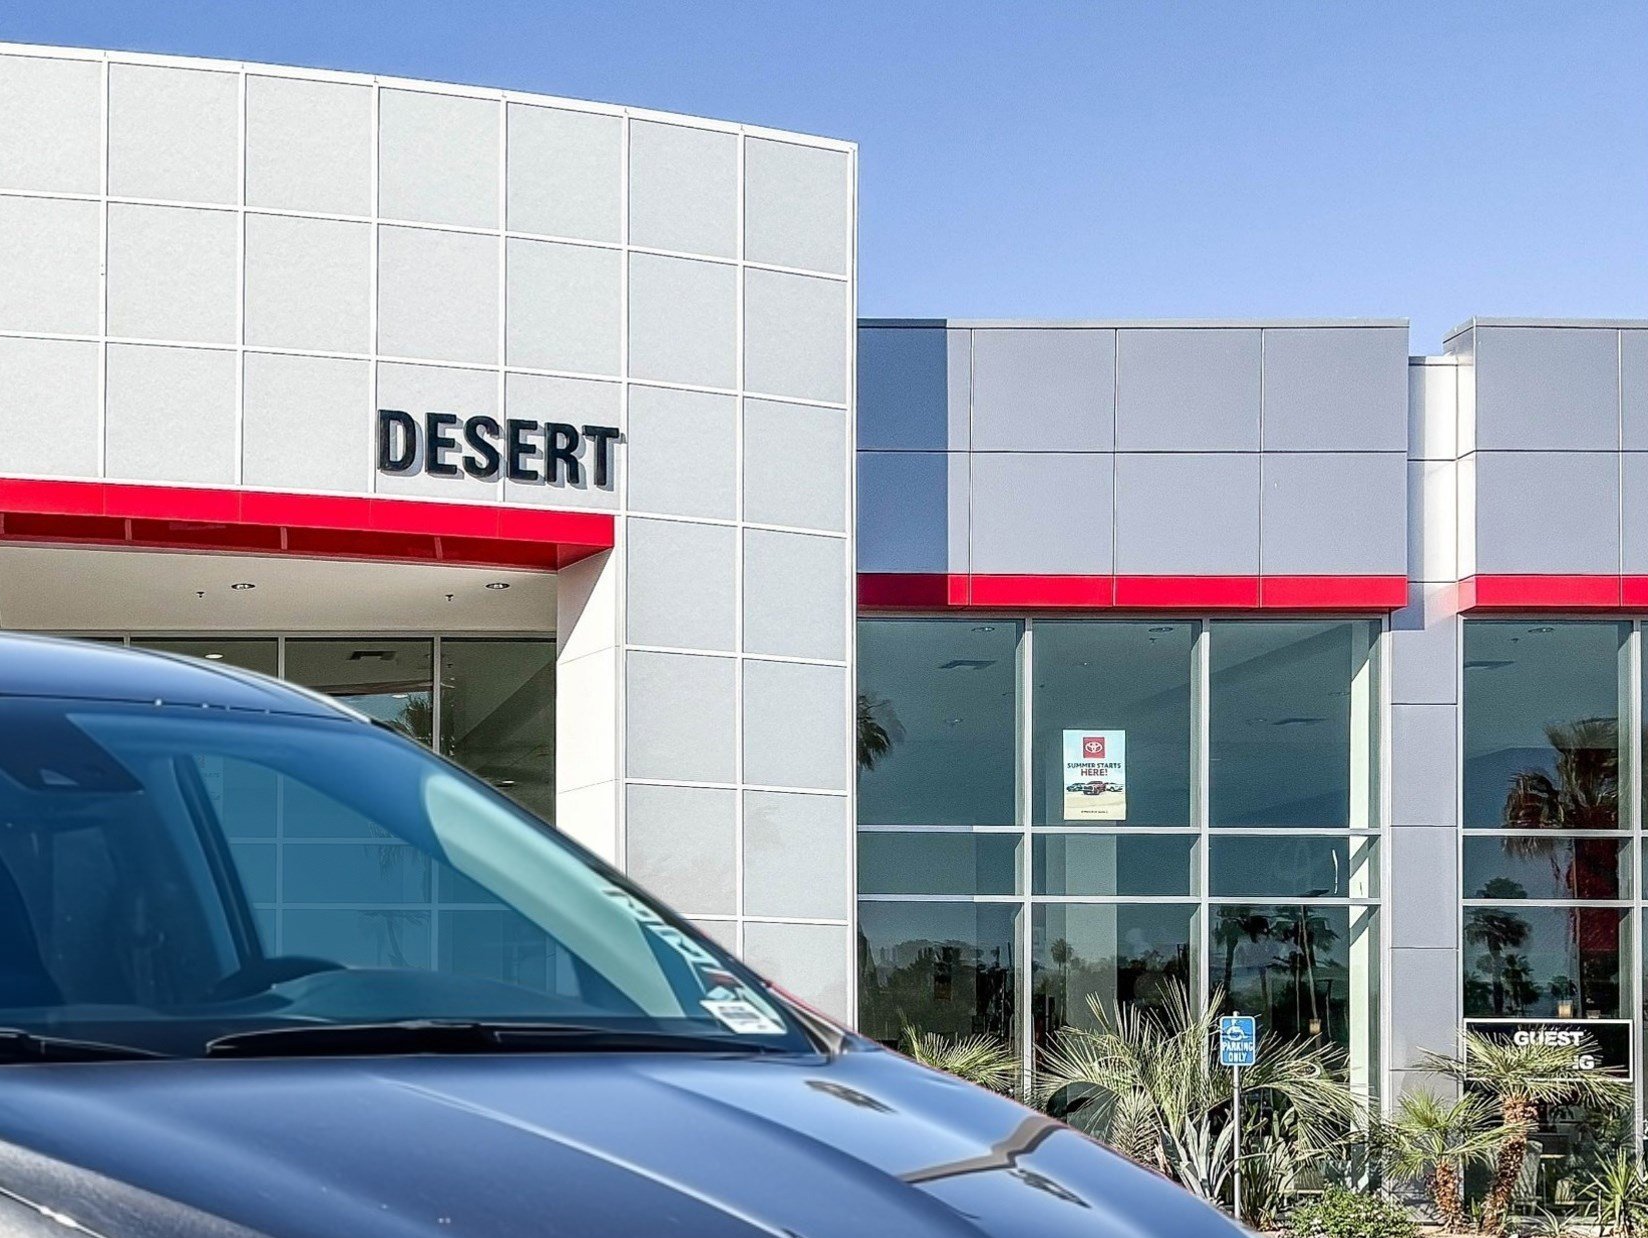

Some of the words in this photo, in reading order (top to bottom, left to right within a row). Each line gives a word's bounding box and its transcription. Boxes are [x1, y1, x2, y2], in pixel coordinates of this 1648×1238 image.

[378, 409, 620, 487] DESERT
[1080, 768, 1108, 777] HERE!
[1513, 1030, 1584, 1047] GUEST
[1222, 1041, 1253, 1052] PARKING
[1228, 1051, 1248, 1063] ONLY
